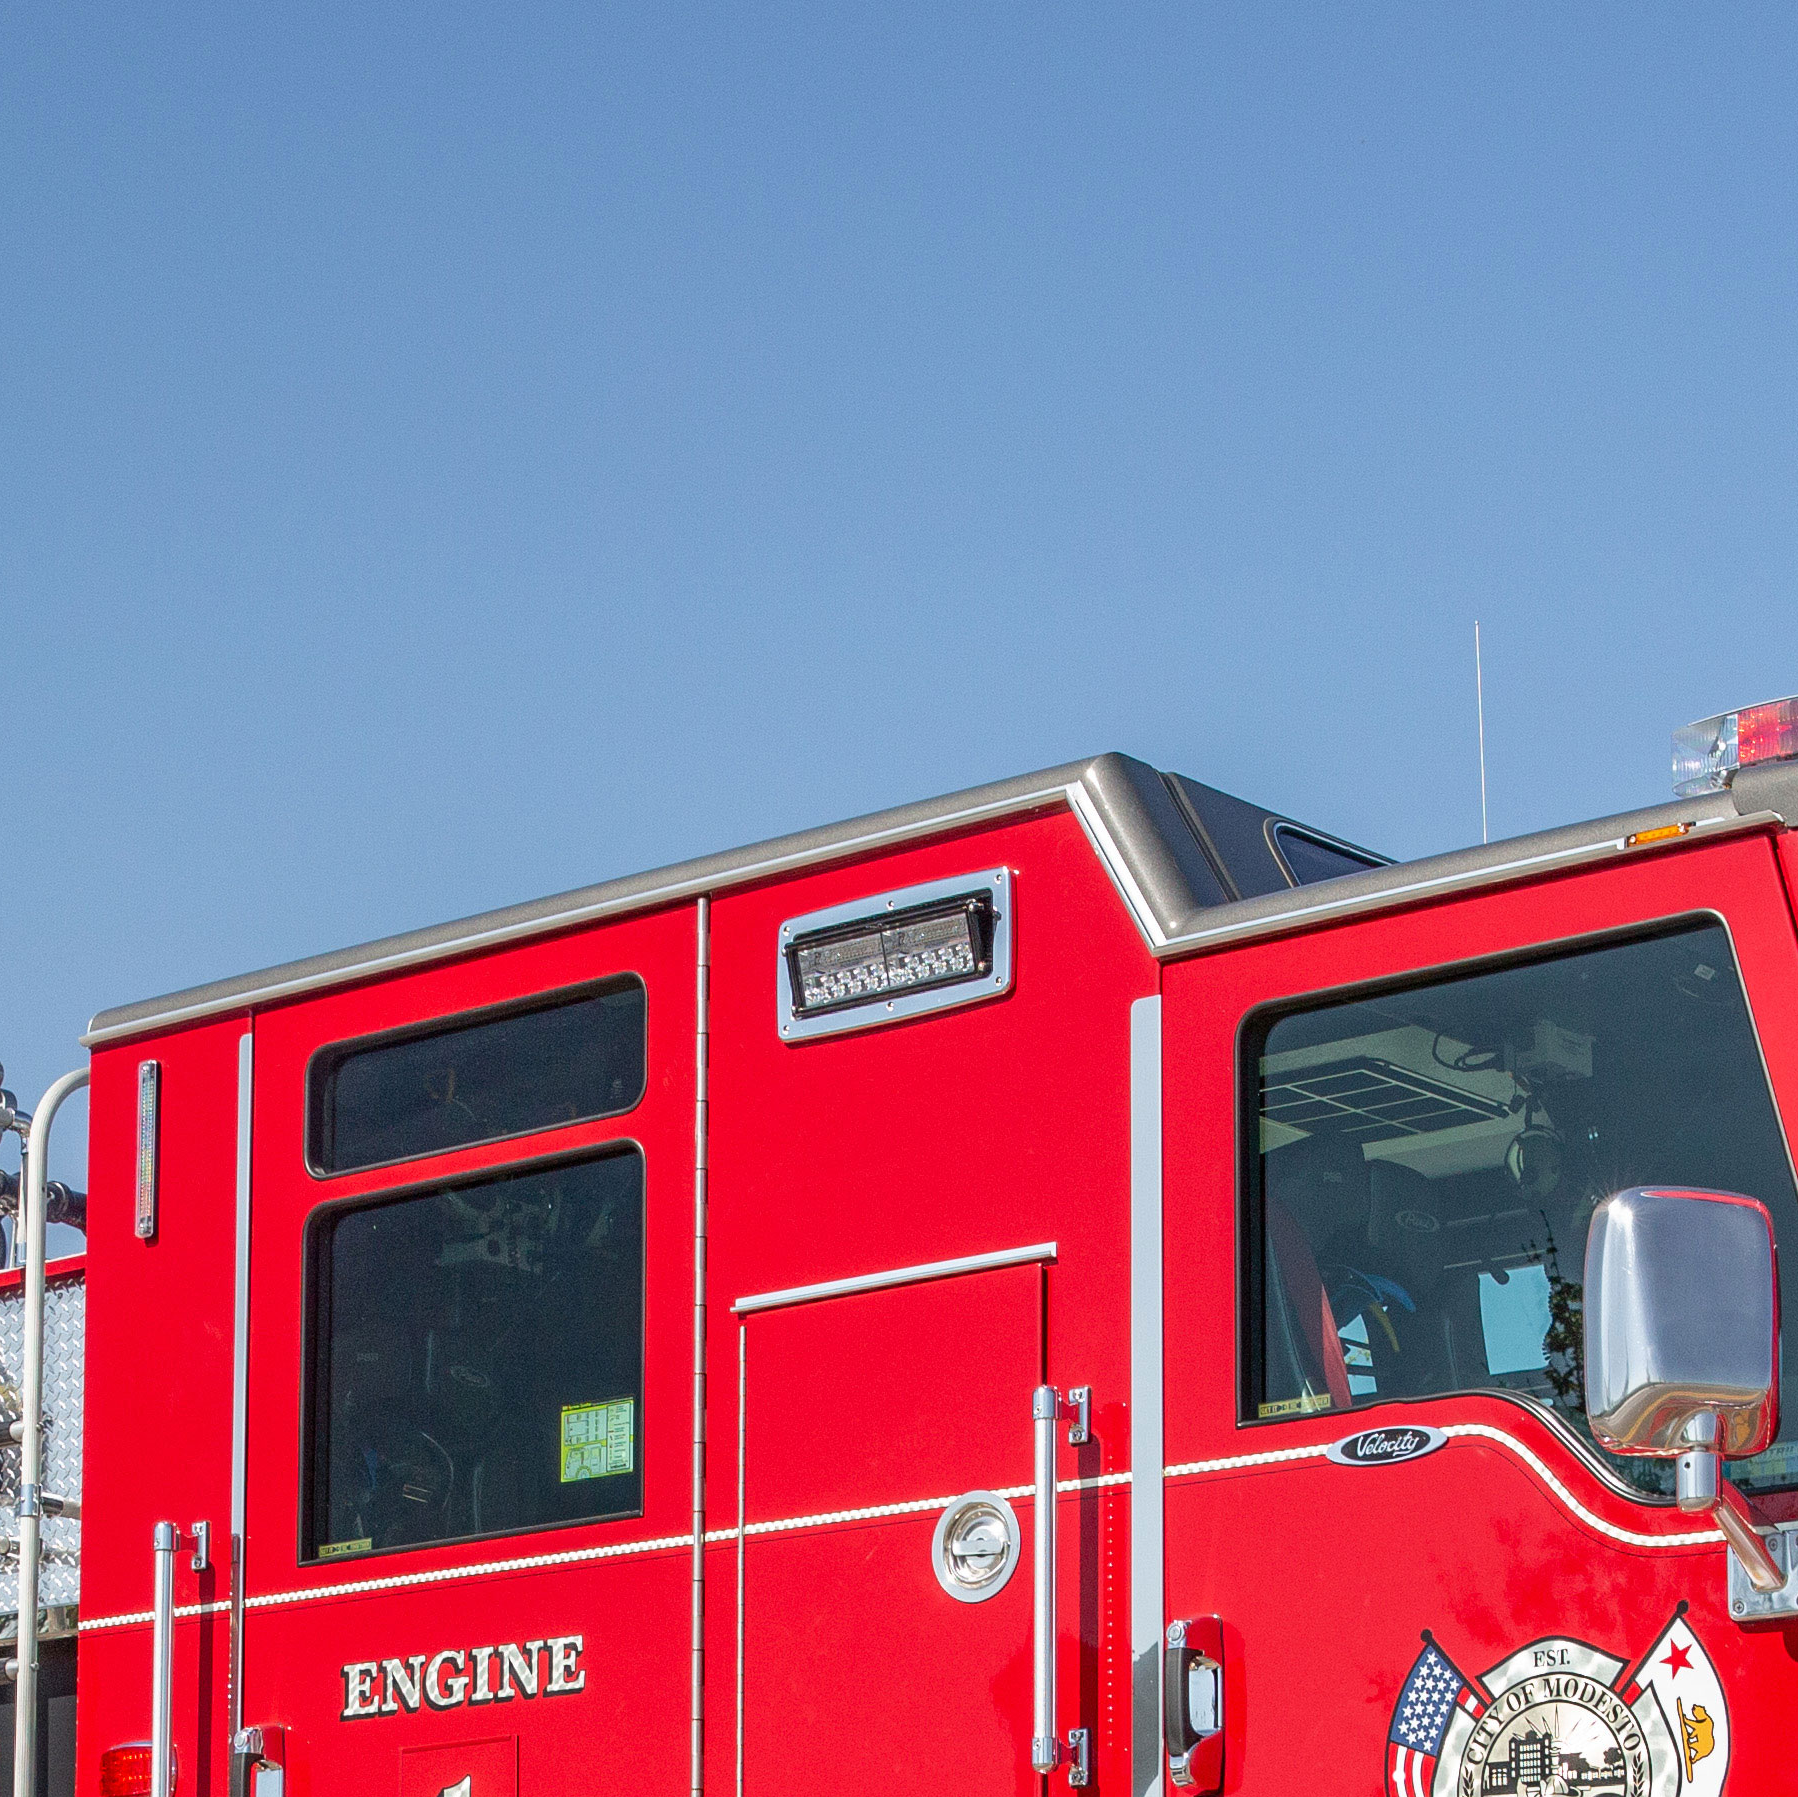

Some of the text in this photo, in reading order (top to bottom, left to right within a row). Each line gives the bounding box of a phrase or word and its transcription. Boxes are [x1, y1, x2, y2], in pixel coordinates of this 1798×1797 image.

[1357, 1430, 1420, 1457] Velocity
[340, 1634, 587, 1721] ENGINE
[1533, 1648, 1571, 1668] EST.
[1466, 1677, 1642, 1765] CITY OF MODESTO
